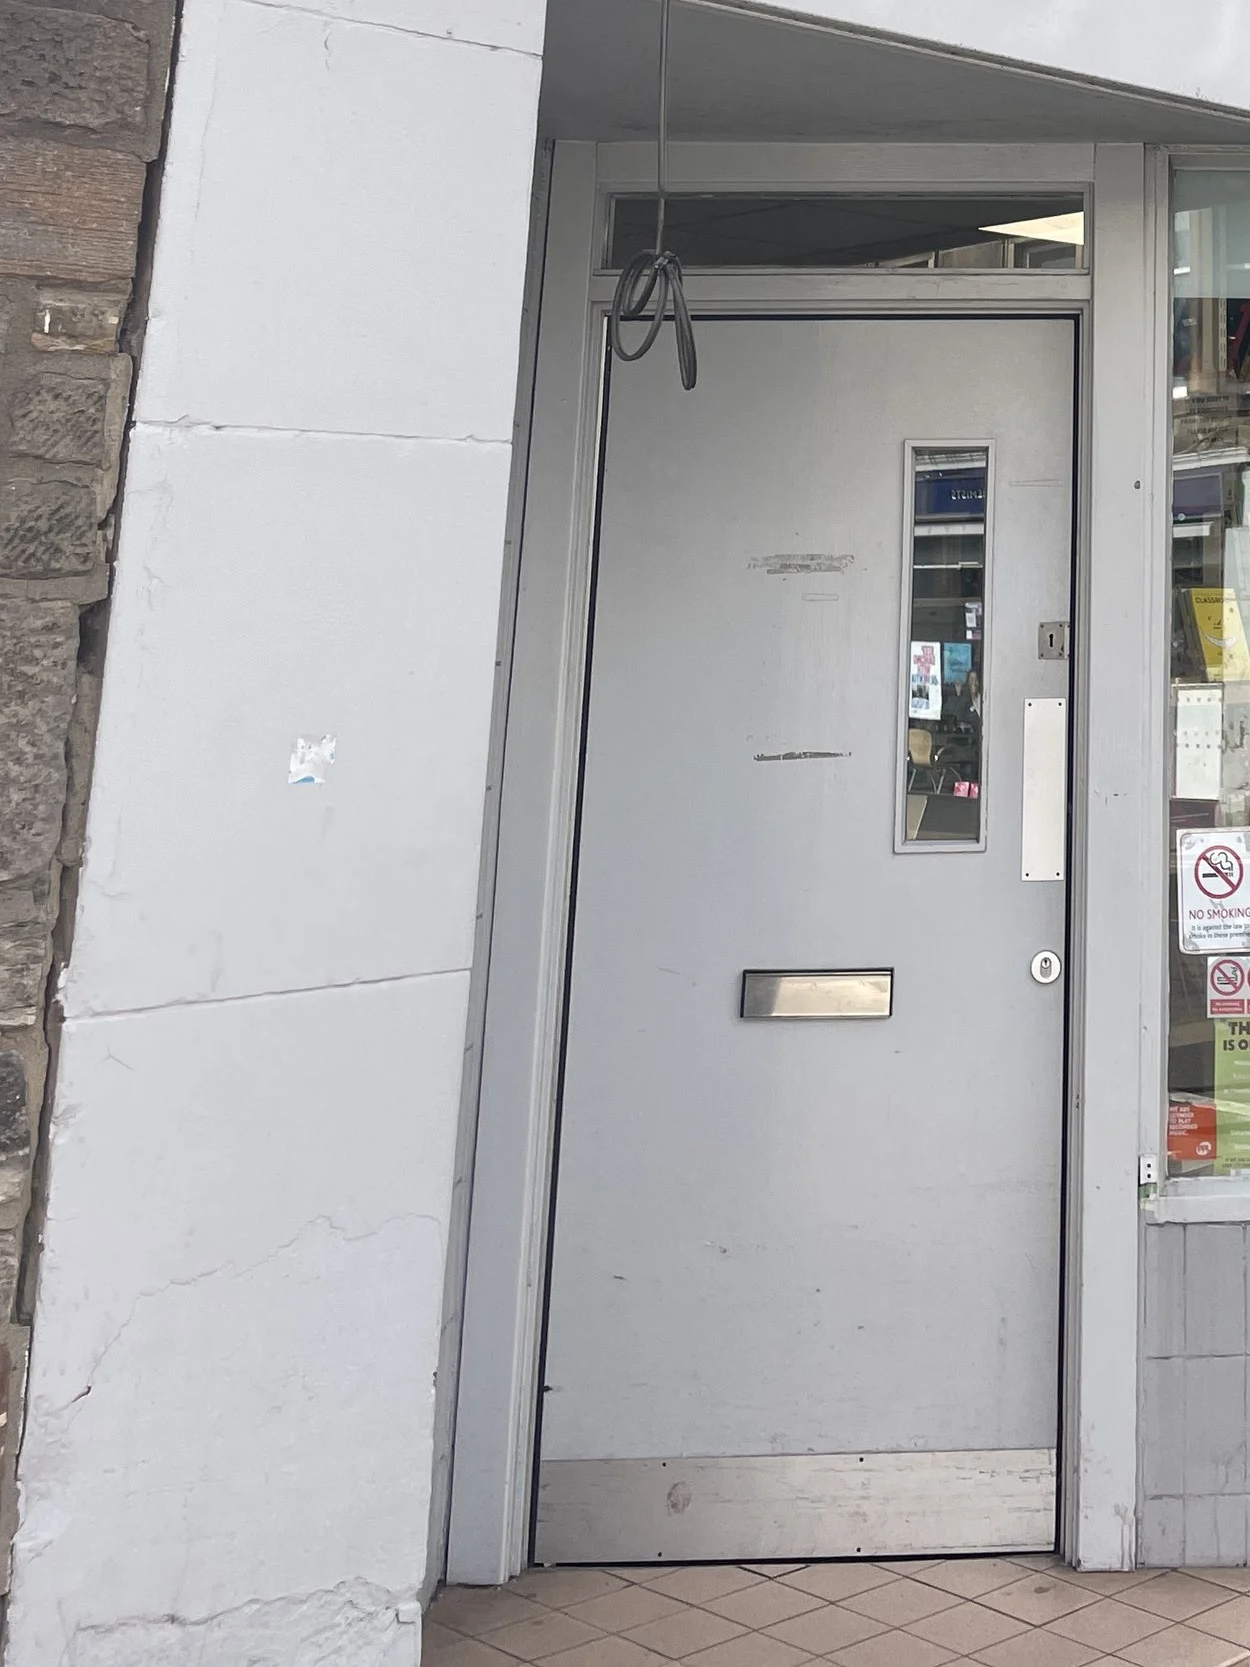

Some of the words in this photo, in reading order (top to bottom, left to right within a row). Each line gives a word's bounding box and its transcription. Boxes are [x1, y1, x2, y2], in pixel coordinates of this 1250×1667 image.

[1189, 910, 1204, 920] NO
[1203, 924, 1222, 932] against
[1223, 1039, 1235, 1051] IS
